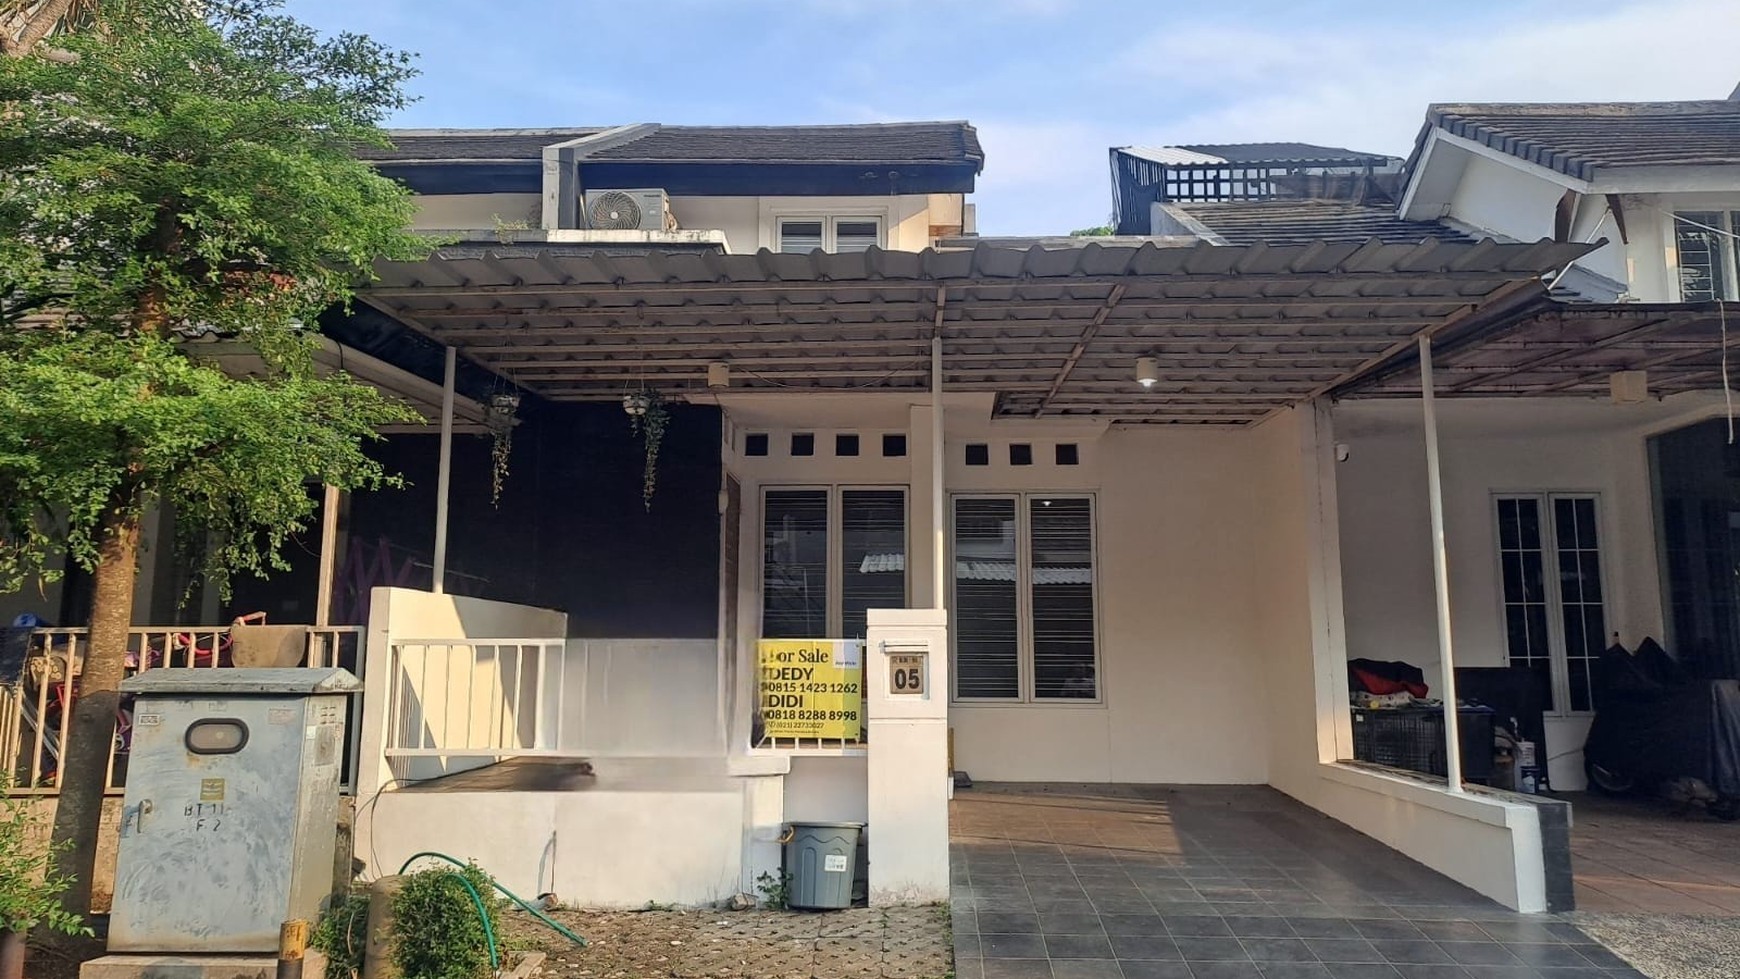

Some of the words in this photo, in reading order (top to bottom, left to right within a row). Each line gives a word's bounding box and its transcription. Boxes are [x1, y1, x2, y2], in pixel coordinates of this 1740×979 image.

[798, 648, 829, 663] Sale
[769, 667, 814, 680] DEDY
[895, 668, 920, 690] 05
[768, 682, 797, 692] 0815
[799, 683, 827, 693] 1423
[829, 683, 858, 694] 1262
[768, 694, 804, 708] DIDI
[768, 709, 797, 720] 0818
[798, 709, 827, 721] 8288
[828, 710, 858, 721] 8998
